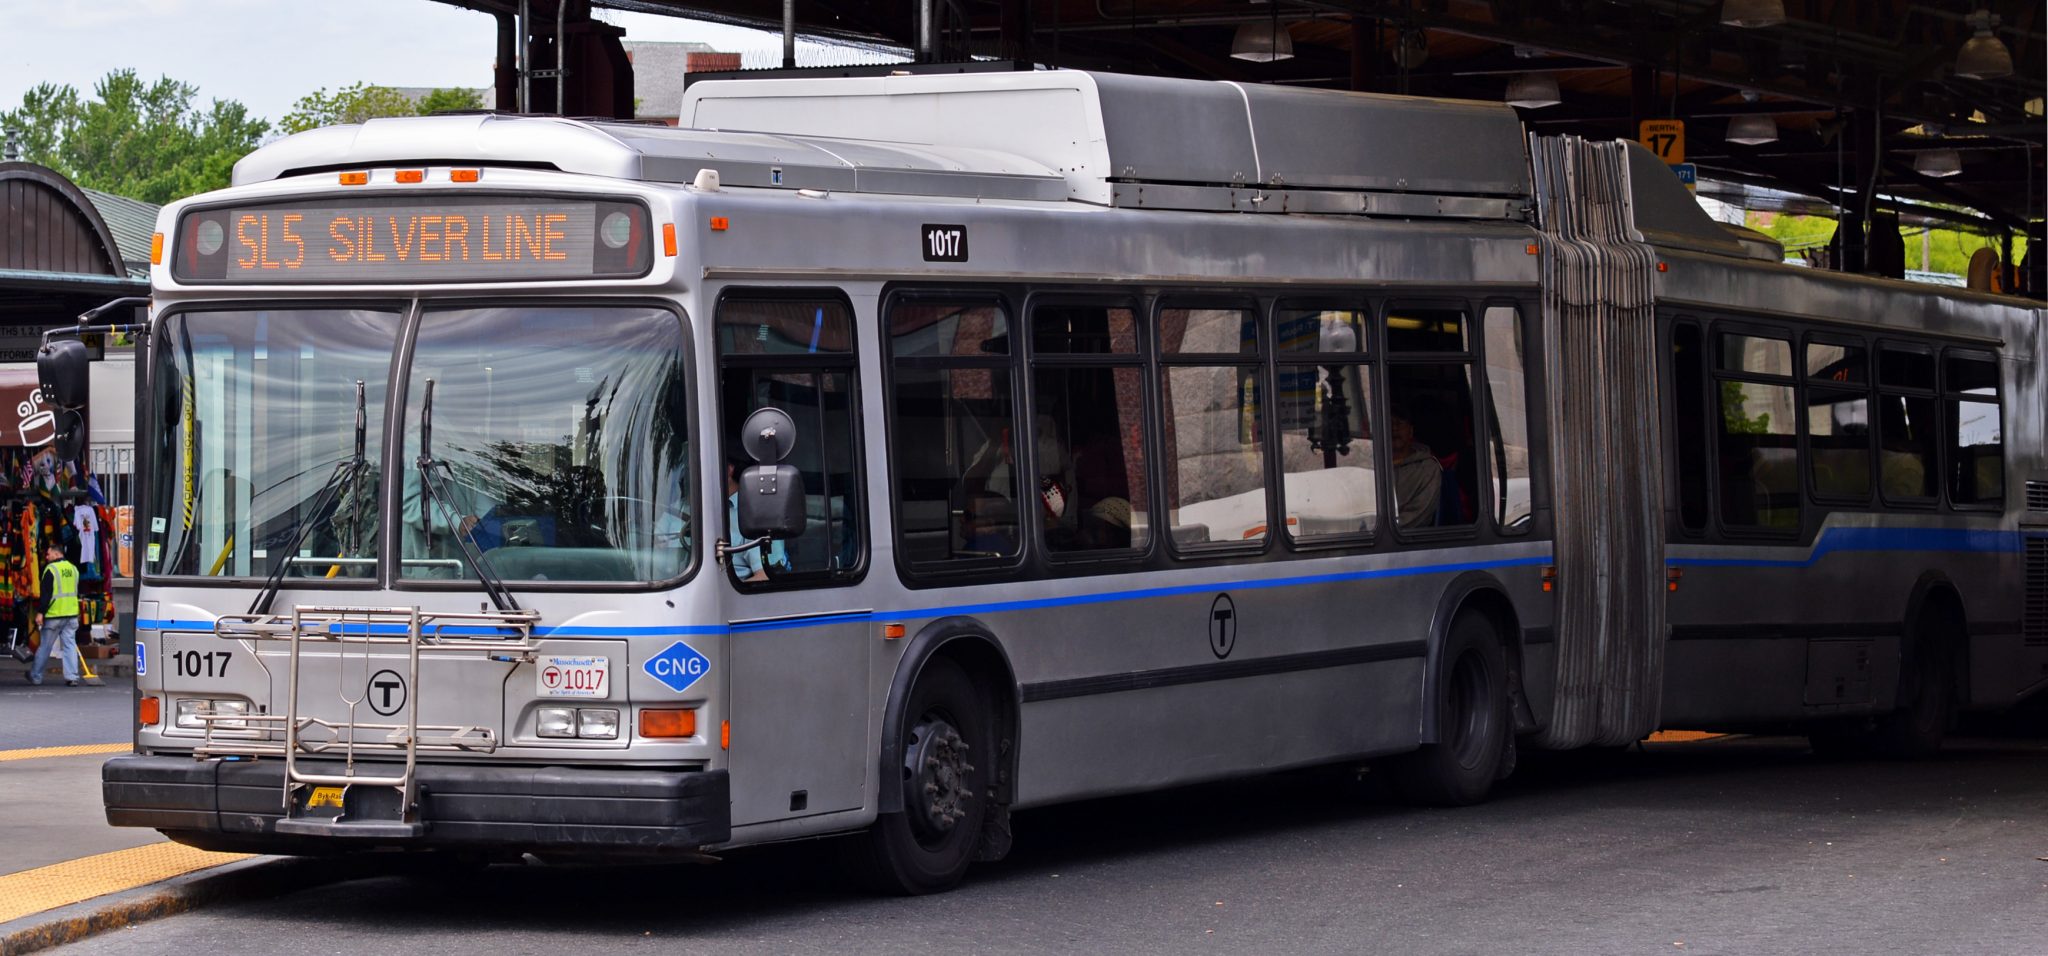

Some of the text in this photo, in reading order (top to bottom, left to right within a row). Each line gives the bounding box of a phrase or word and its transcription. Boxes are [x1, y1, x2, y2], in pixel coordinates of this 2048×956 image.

[1647, 133, 1677, 158] 17
[237, 215, 567, 269] SL5 SILVER LINE
[928, 229, 961, 257] 1017
[184, 466, 192, 500] HOLD
[173, 650, 232, 678] 1017
[654, 657, 701, 677] CNG
[565, 669, 605, 690] 1017
